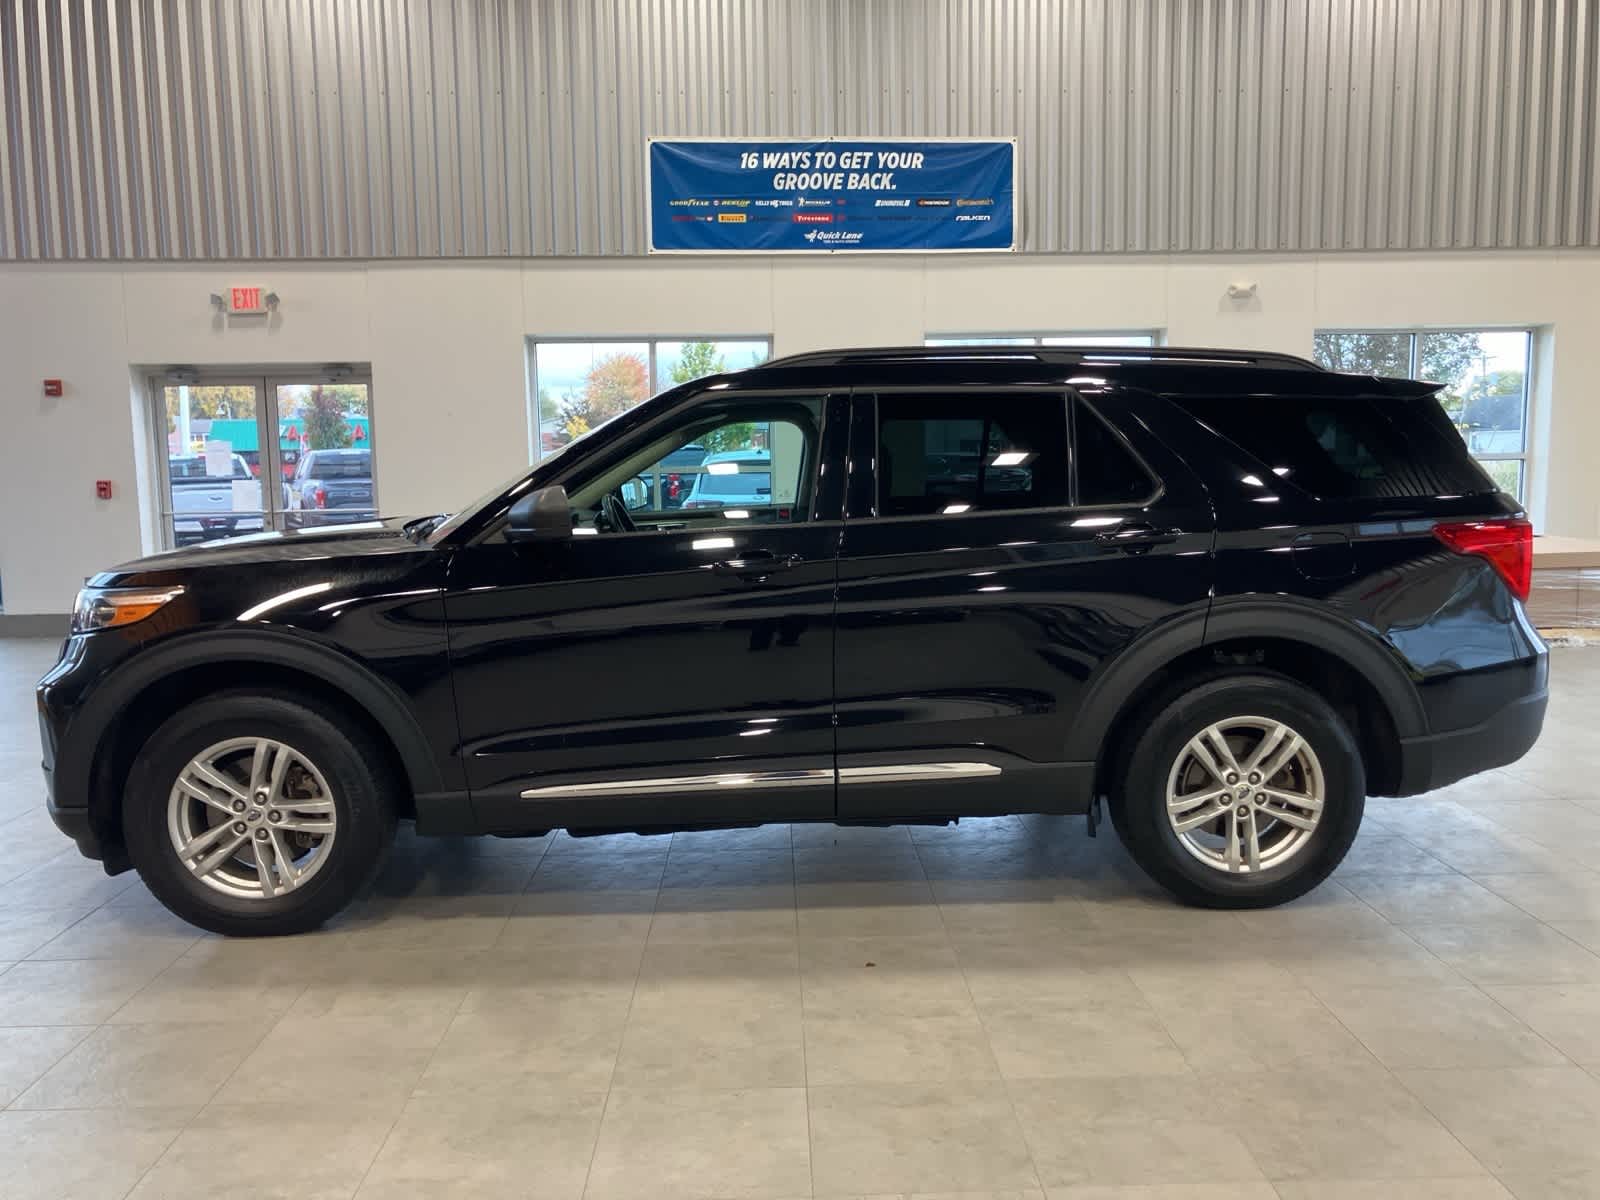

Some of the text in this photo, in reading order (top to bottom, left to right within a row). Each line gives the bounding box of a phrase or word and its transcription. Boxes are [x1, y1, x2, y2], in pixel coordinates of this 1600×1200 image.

[740, 152, 924, 169] 16 WAYS TO GET YOUR
[773, 173, 897, 190] GROOVE BACK.
[816, 231, 863, 240] Quick Lane
[231, 287, 260, 310] EXIT
